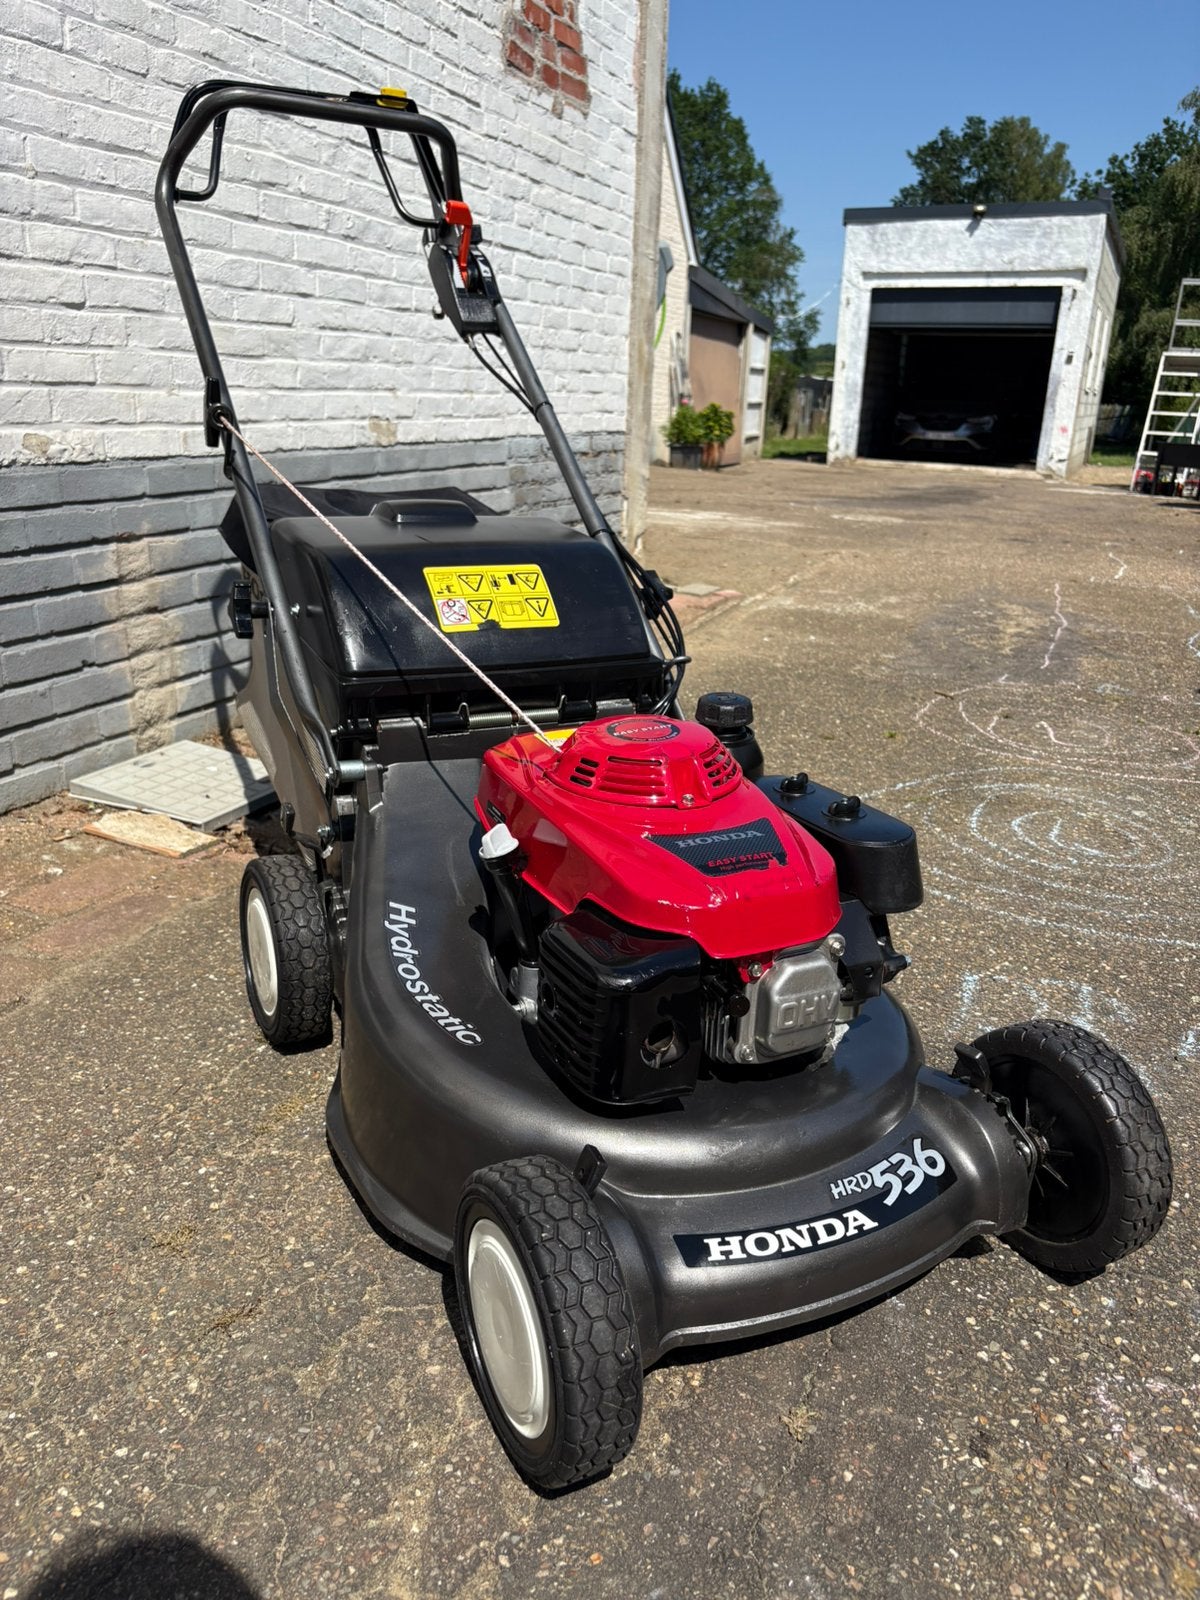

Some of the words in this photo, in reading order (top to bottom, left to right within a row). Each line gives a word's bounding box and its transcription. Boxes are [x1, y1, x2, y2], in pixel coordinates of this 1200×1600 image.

[675, 830, 765, 848] HONDA
[707, 857, 737, 868] EASY
[739, 852, 773, 862] START
[384, 901, 482, 1044] Hydrostatic
[778, 991, 838, 1030] OHV
[703, 1209, 879, 1261] HONDA
